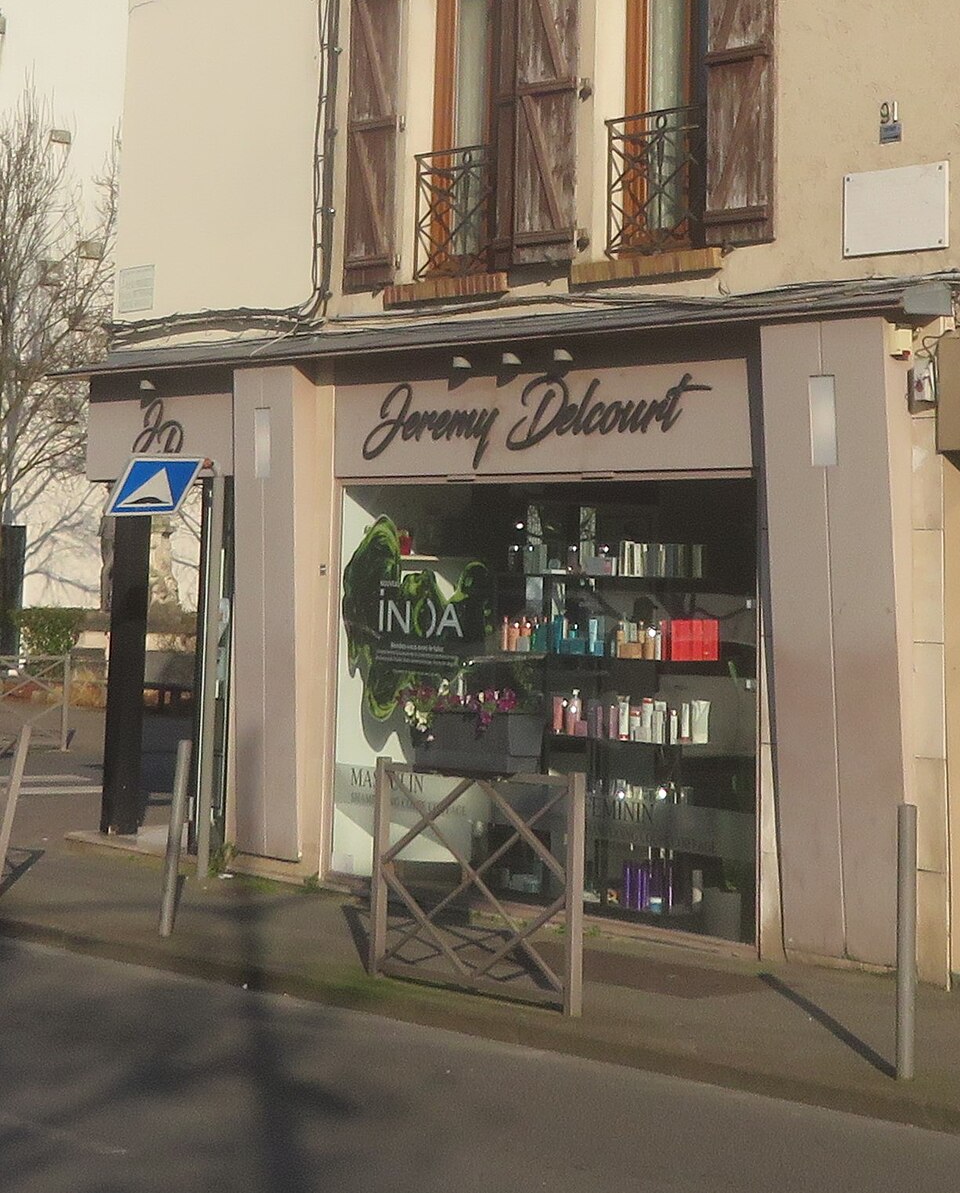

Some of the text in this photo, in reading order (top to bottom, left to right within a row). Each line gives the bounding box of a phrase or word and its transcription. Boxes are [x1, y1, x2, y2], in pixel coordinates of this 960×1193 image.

[880, 101, 898, 124] 91
[362, 372, 712, 470] Jeremy Delcourt
